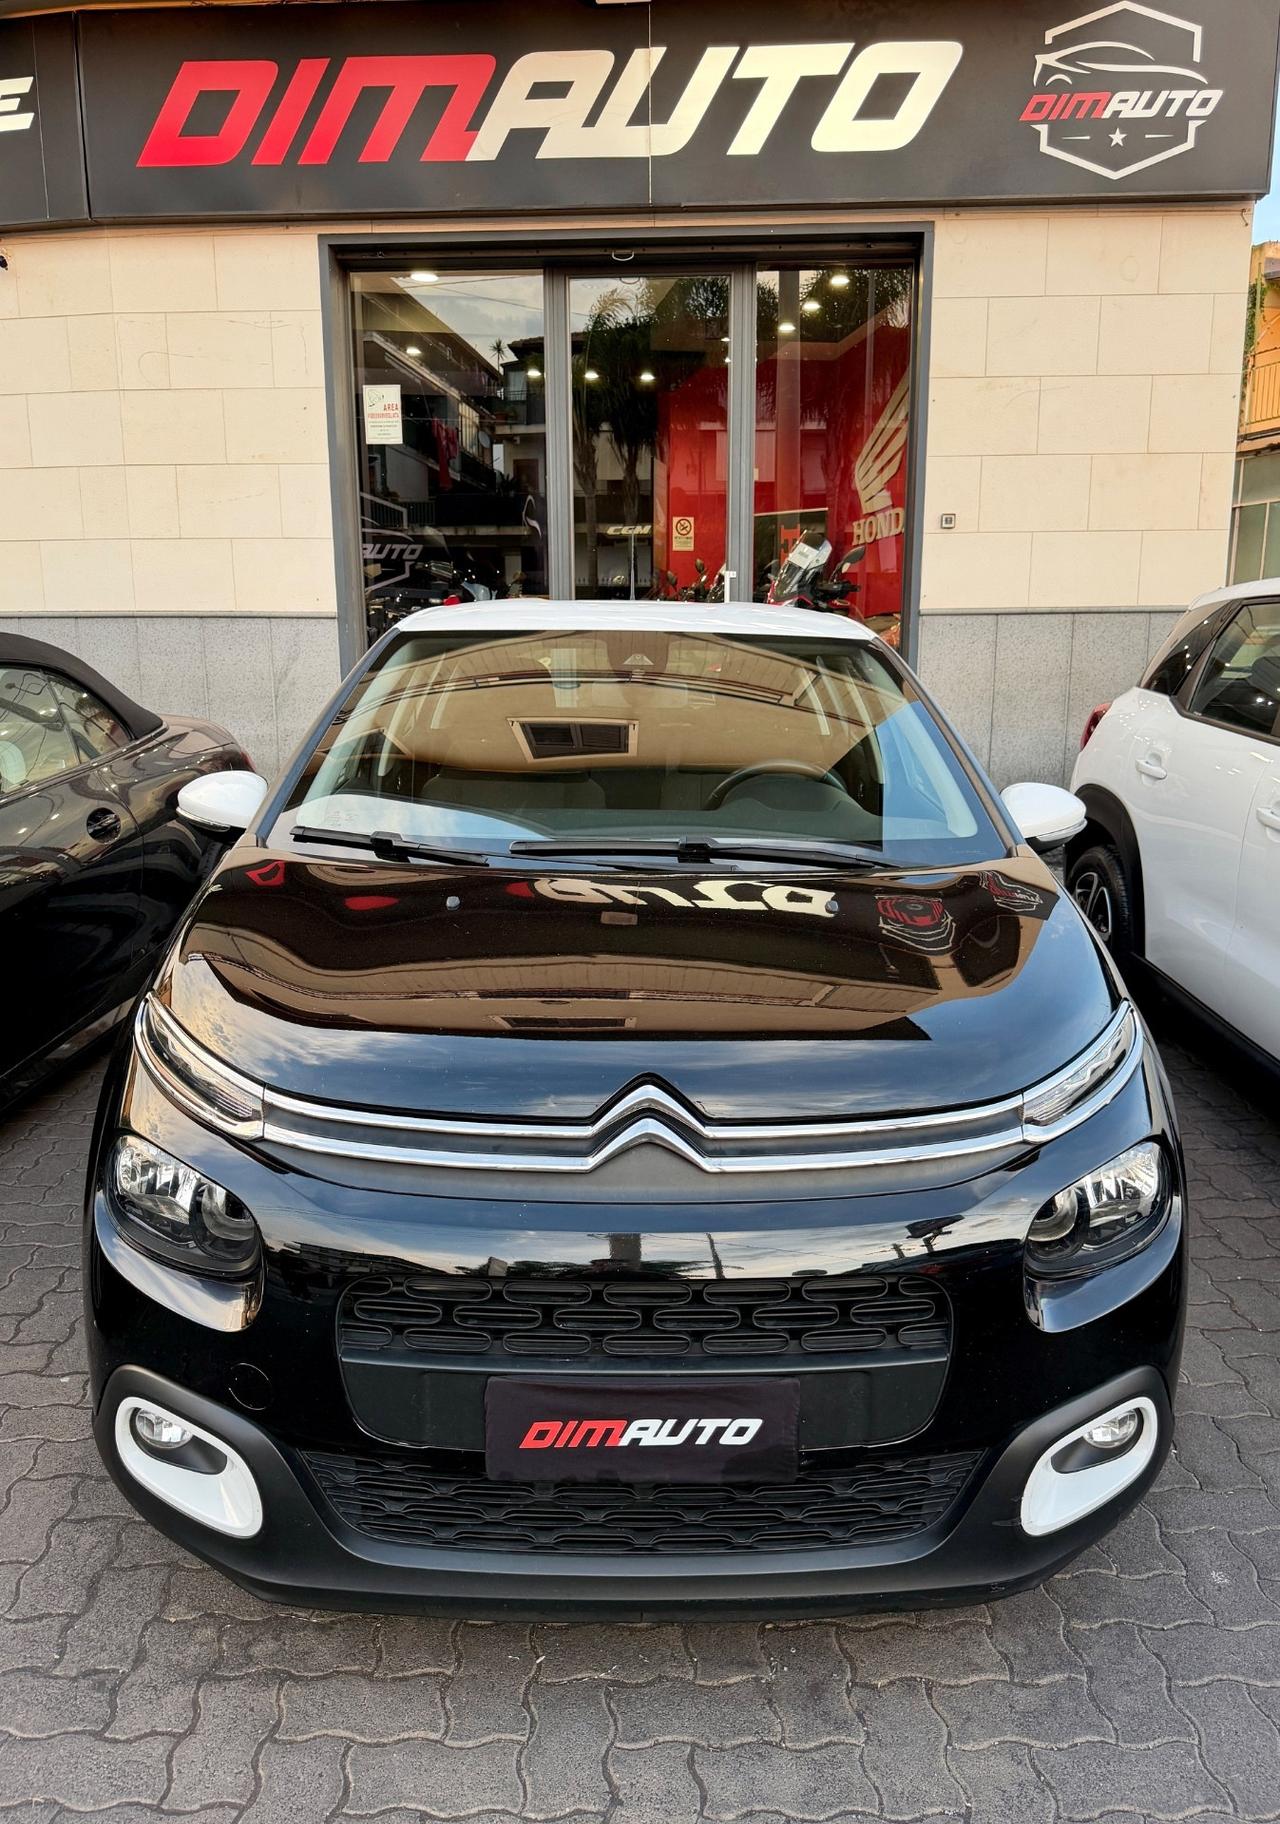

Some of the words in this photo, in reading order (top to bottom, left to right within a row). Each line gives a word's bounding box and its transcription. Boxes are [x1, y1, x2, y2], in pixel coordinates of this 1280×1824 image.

[136, 40, 964, 168] DIMAUTO
[1019, 89, 1224, 121] DIMAUTO
[851, 507, 904, 546] HOND
[518, 1418, 763, 1448] DIMAUTO
